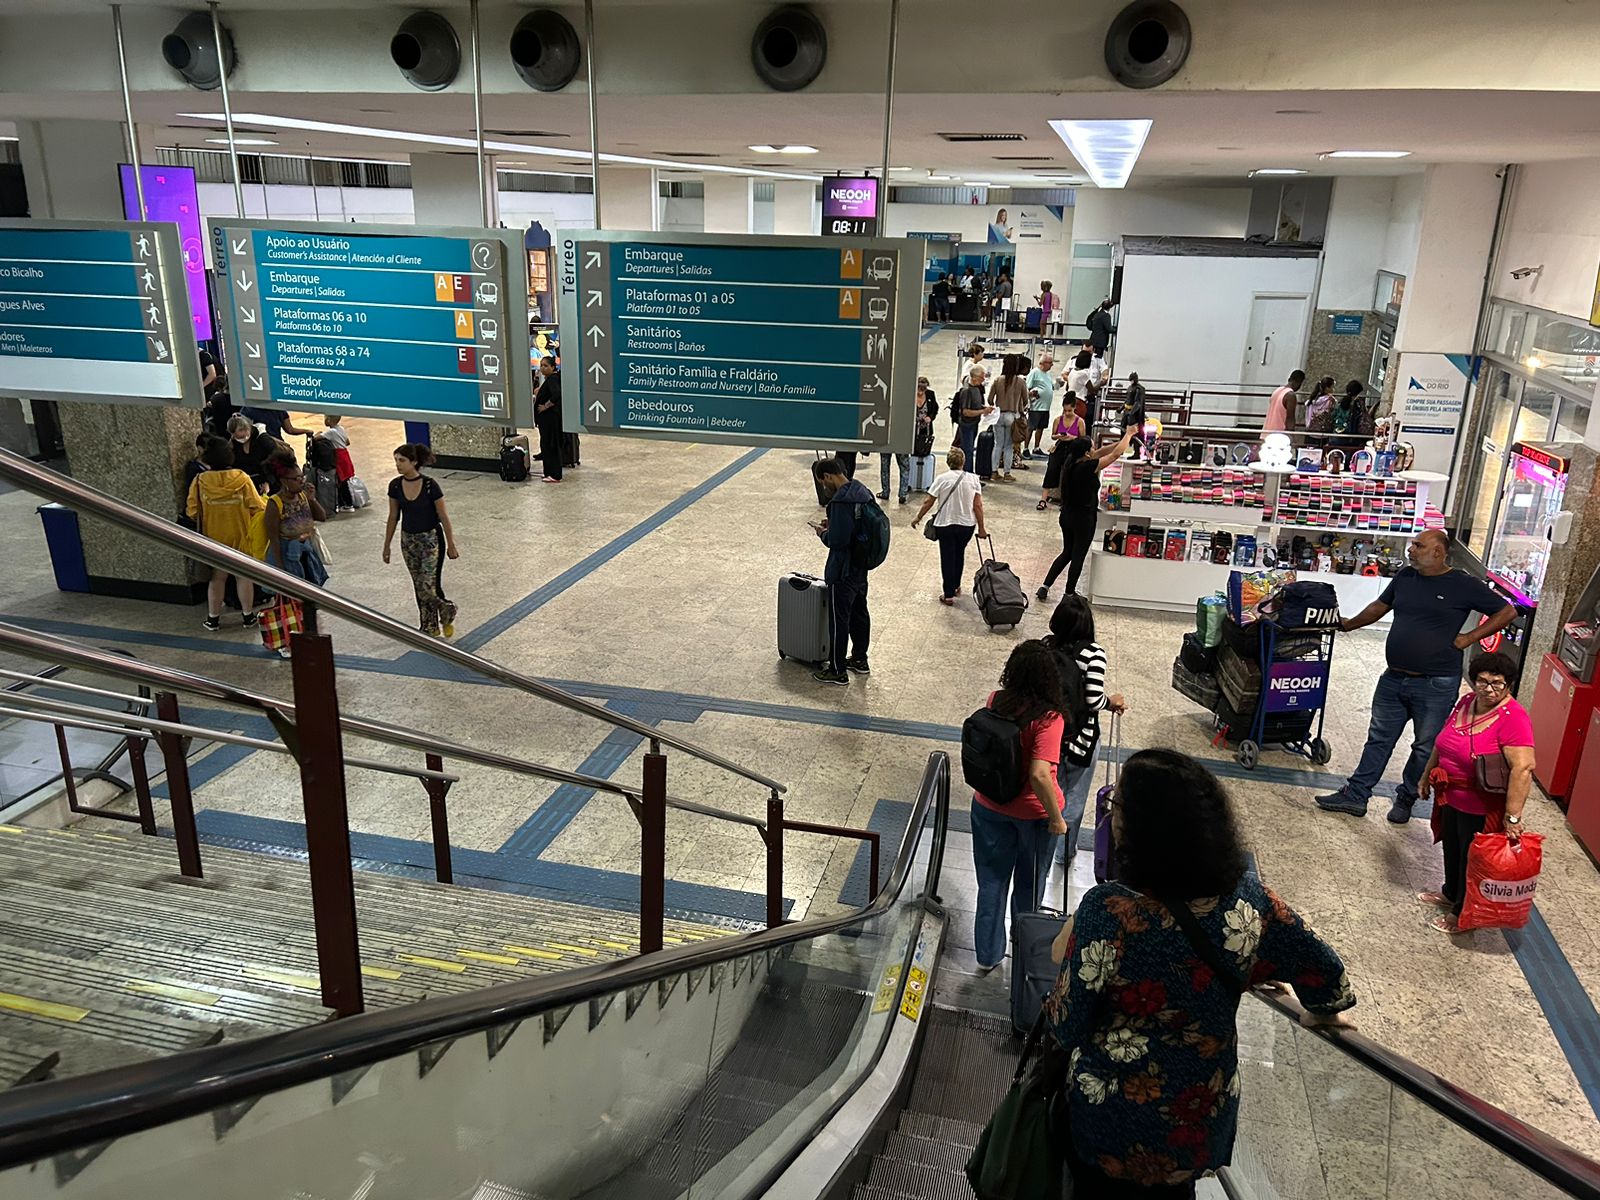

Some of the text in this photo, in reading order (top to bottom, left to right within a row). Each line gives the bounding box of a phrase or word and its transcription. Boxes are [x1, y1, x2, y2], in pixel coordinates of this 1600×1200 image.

[831, 189, 870, 200] NEOOH
[832, 220, 866, 233] 08:11
[266, 236, 350, 250] Apoio ao Usuário
[213, 227, 227, 278] Térreo
[268, 250, 422, 265] Customer's Assistance Atención al Cliente
[625, 248, 684, 264] Embarque
[844, 250, 855, 264] A
[12, 267, 44, 278] Bicalho
[563, 239, 575, 295] Térreo
[625, 263, 712, 275] Departures Salidas
[270, 271, 320, 284] Embarque
[437, 276, 462, 289] A E
[272, 285, 346, 297] Departures Salidas
[626, 289, 735, 304] Plataformas 01 a 05
[842, 291, 854, 304] A
[22, 300, 45, 311] Alves
[626, 303, 700, 315] Platform 01 to 05
[274, 308, 367, 323] Plataformas 06 a 10
[457, 313, 467, 326] A
[275, 321, 342, 332] Platforms 06 to 10
[627, 325, 682, 338] Sanitários
[1, 343, 16, 352] Men
[277, 342, 333, 355] Plataformas
[335, 347, 348, 356] 68
[358, 347, 370, 358] 74
[628, 340, 706, 351] Restrooms Baños
[279, 355, 345, 367] Platforms 68 to 74
[458, 348, 467, 361] E
[628, 362, 778, 382] Sanitário Família e Fraldário
[281, 374, 322, 386] Elevador
[628, 377, 816, 395] Family Restroom and Nursery Baño Familia
[283, 387, 351, 399] Elevator Ascensor
[628, 398, 694, 413] Bebedouros
[628, 412, 747, 428] Drinking Fountain Bebeder
[1304, 607, 1339, 624] PINK
[1270, 676, 1321, 690] NEOOH
[1484, 883, 1512, 896] Silvia
